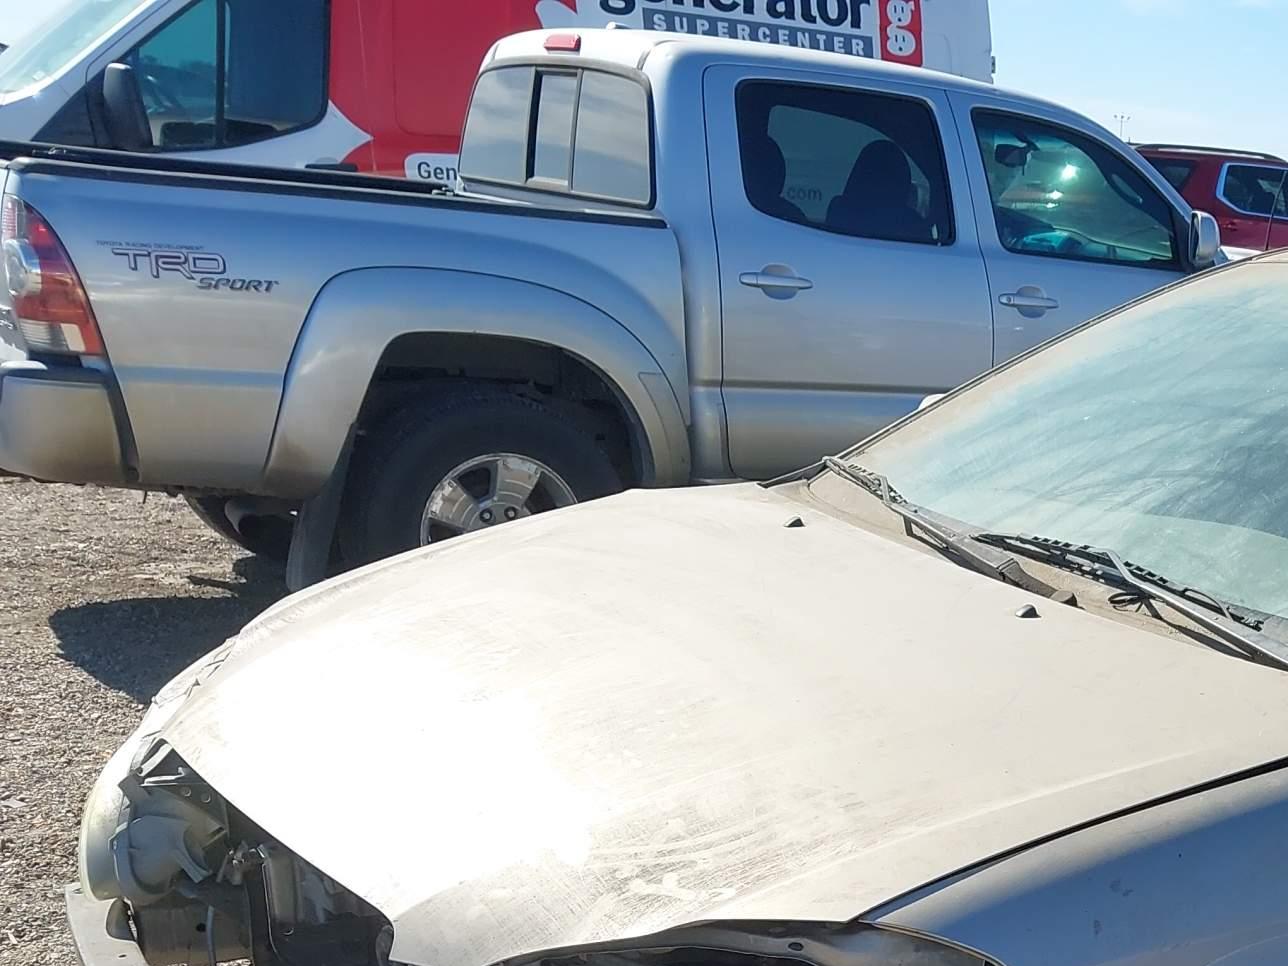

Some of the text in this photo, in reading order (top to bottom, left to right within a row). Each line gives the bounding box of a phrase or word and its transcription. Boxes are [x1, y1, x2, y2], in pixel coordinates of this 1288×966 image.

[653, 13, 865, 57] SUPERCENTER
[417, 161, 458, 181] Gen
[112, 248, 226, 281] TRD
[197, 277, 276, 293] SPORT
